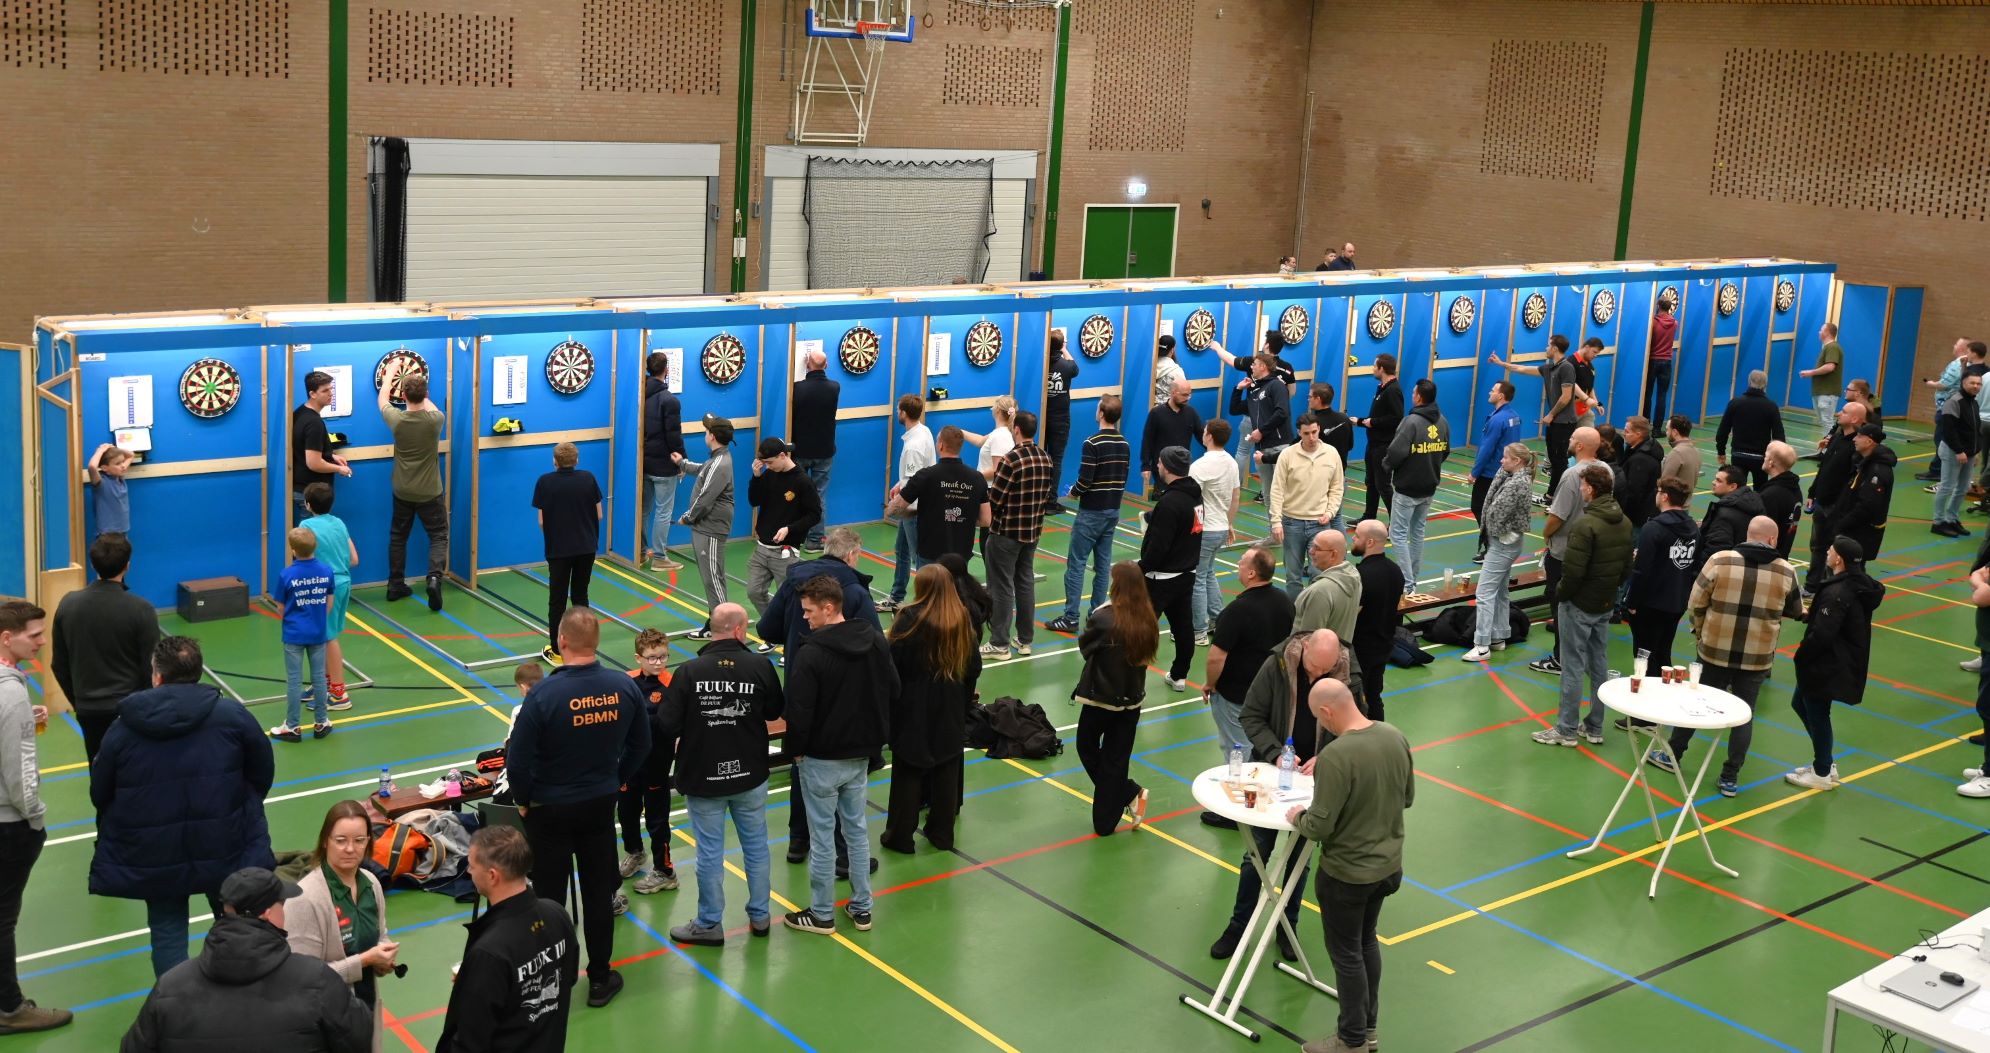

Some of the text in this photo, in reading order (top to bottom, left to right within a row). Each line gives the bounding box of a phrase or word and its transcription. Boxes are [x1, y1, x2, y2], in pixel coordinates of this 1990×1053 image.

[940, 480, 959, 489] Break
[291, 576, 329, 588] Kristian
[294, 586, 328, 597] van der
[695, 680, 755, 694] FUUK III
[569, 691, 619, 711] Official
[572, 709, 618, 727] DBMN
